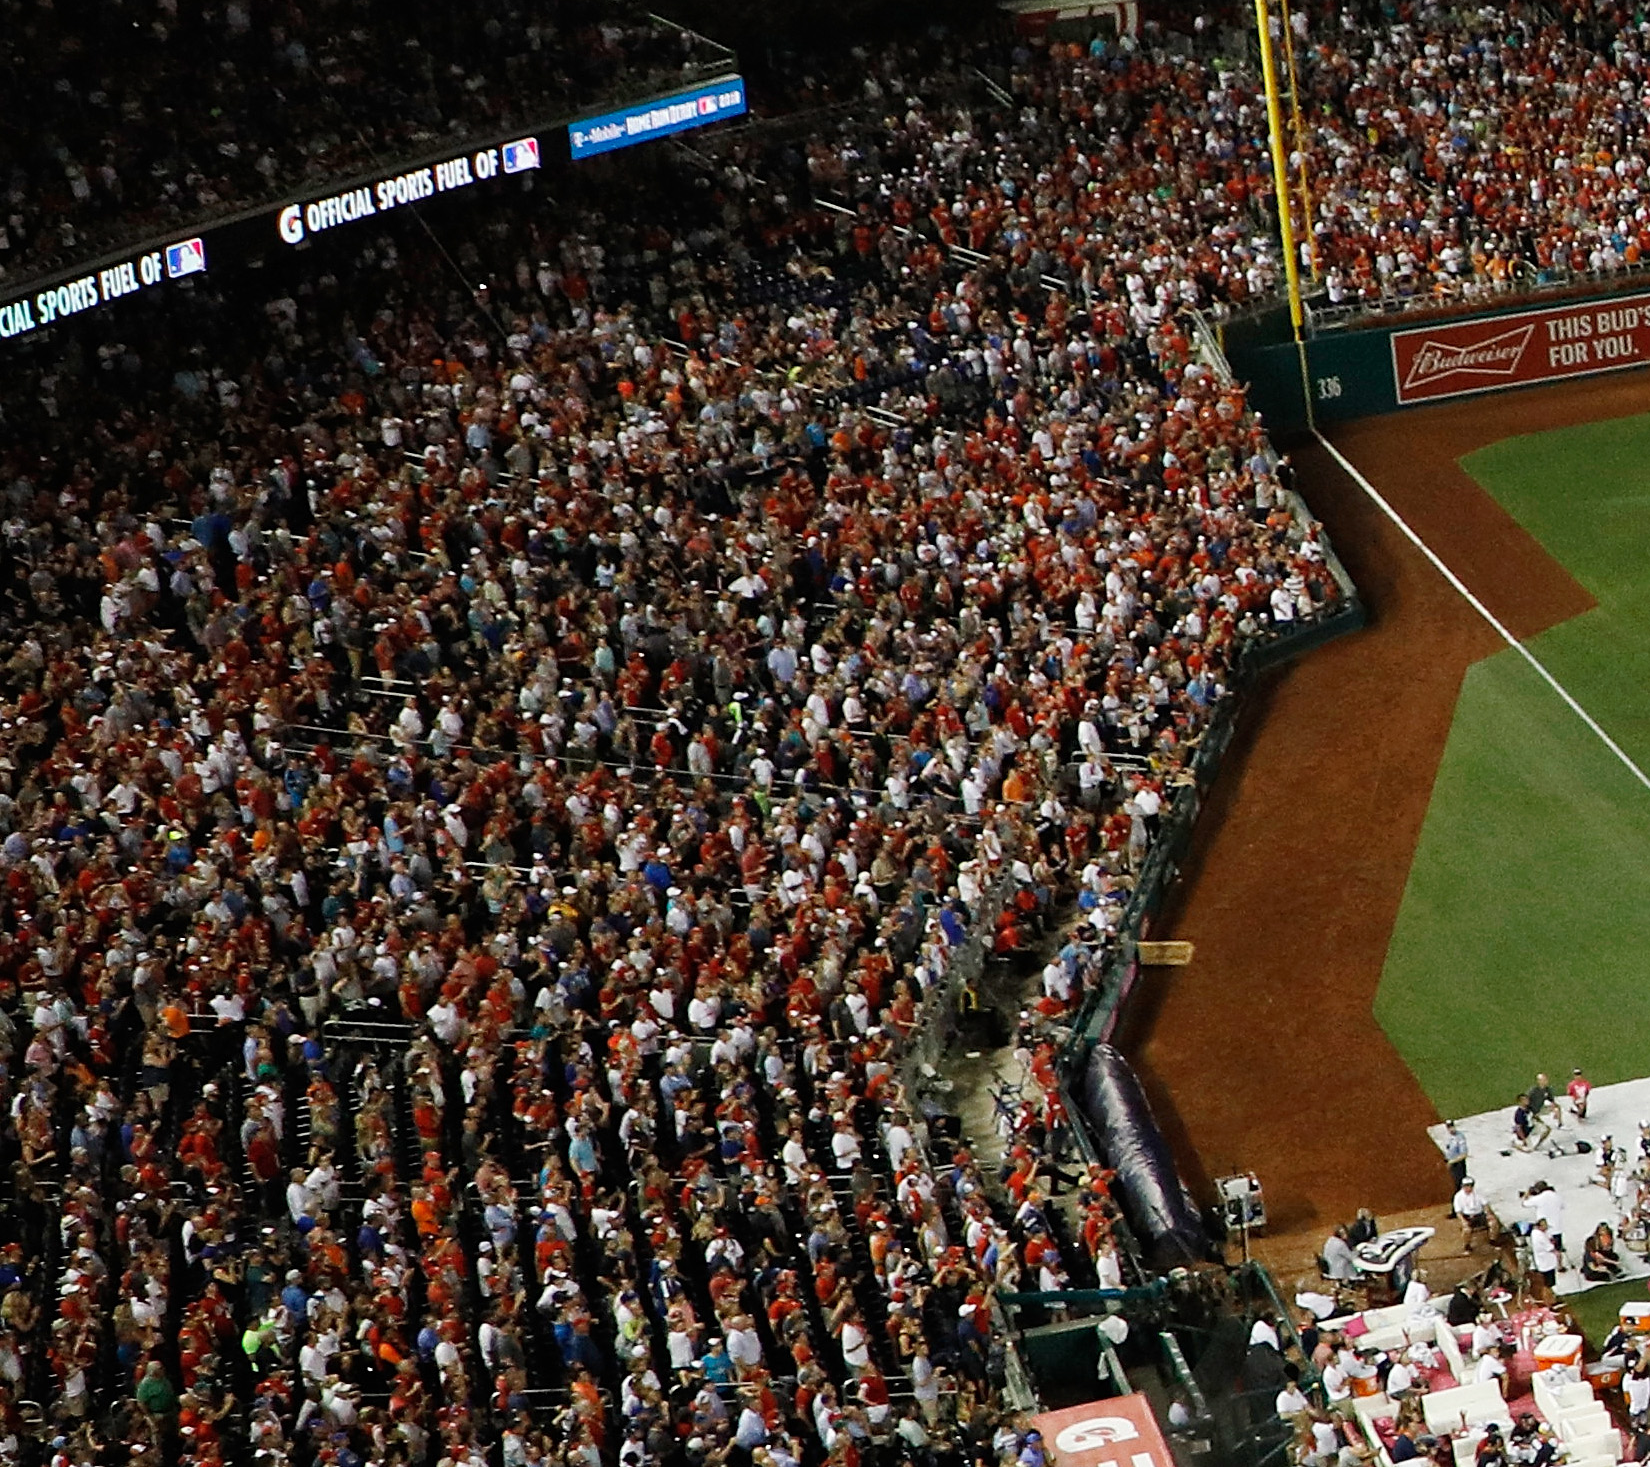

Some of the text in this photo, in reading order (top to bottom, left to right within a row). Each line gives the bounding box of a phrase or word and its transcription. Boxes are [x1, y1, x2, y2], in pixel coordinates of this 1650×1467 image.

[306, 149, 499, 233] OFFICIAL SPORTS FUEL OF
[36, 252, 163, 324] SPORTS FUEL OF
[1545, 316, 1593, 342] THIS
[1550, 334, 1640, 369] FOR YOU.
[1316, 375, 1342, 400] 336
